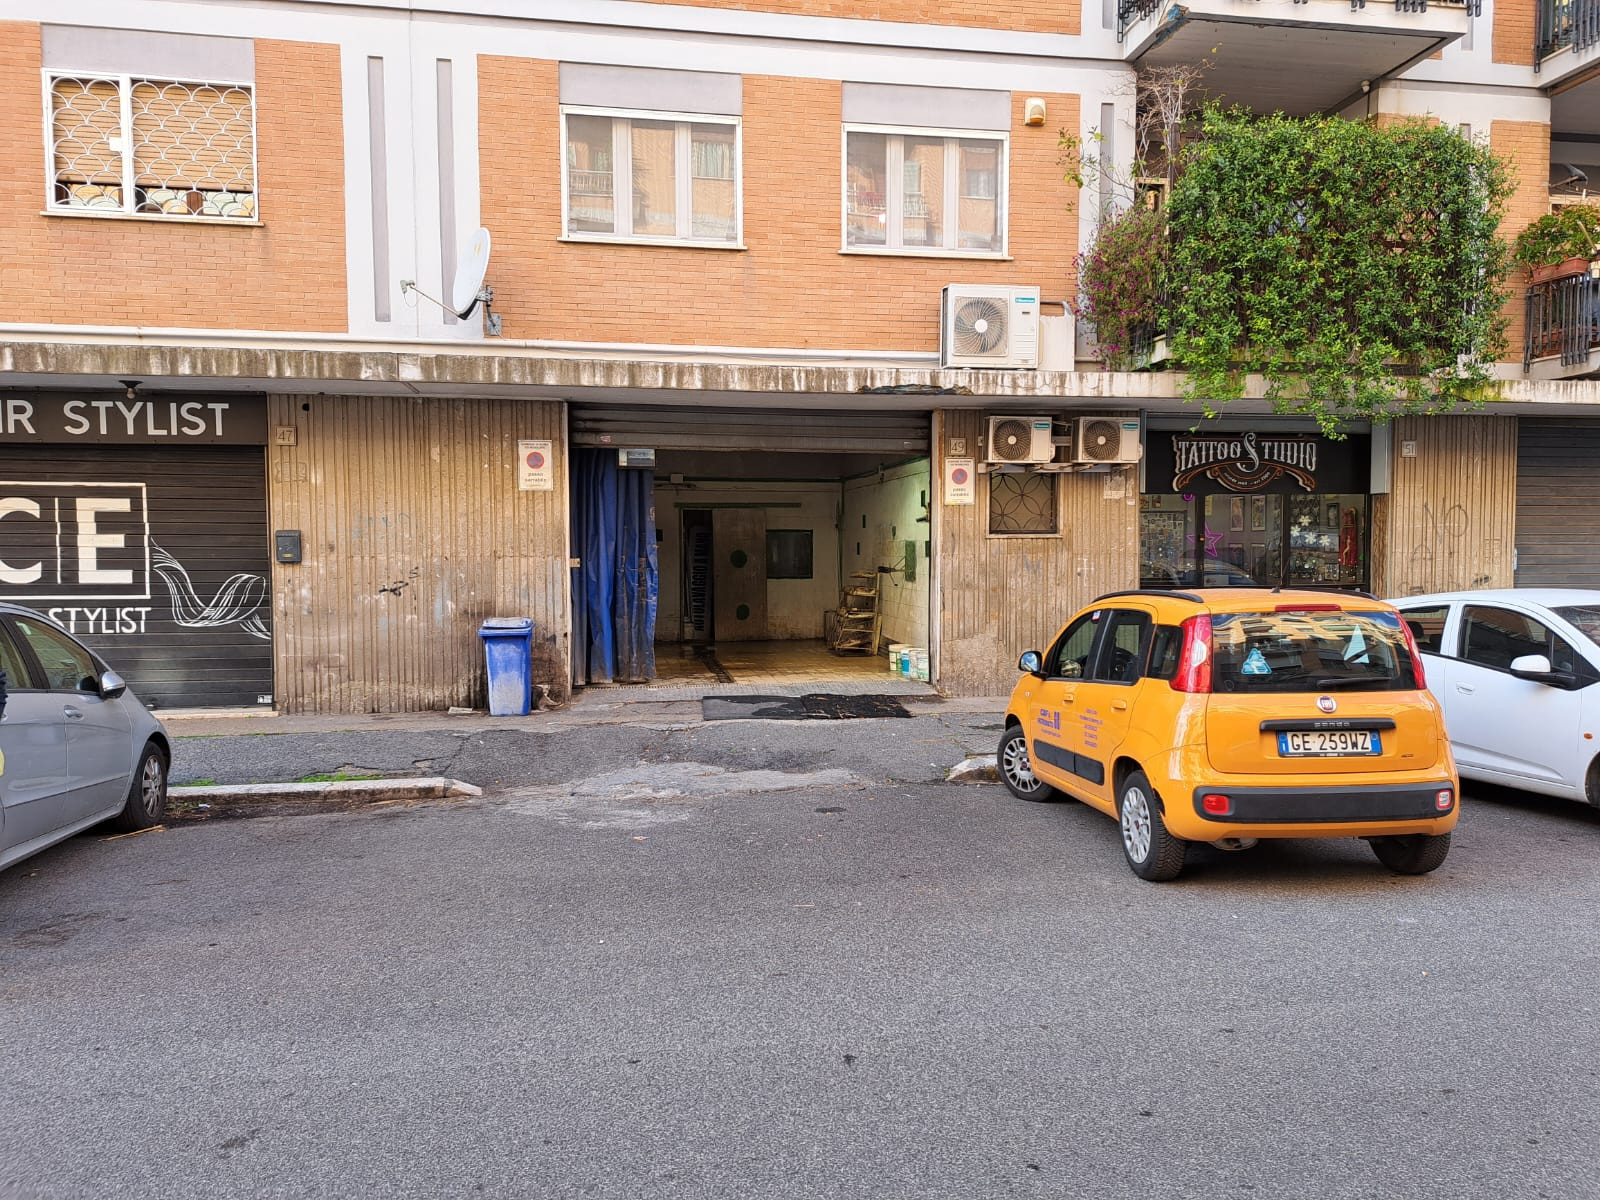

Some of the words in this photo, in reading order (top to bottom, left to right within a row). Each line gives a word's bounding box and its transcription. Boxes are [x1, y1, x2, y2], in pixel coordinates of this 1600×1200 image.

[64, 400, 229, 436] STYLIST
[278, 429, 293, 441] 47
[952, 441, 964, 452] 49
[1179, 441, 1241, 471] TATTOO
[1236, 432, 1317, 473] STUDIO
[48, 607, 151, 634] STYLIST
